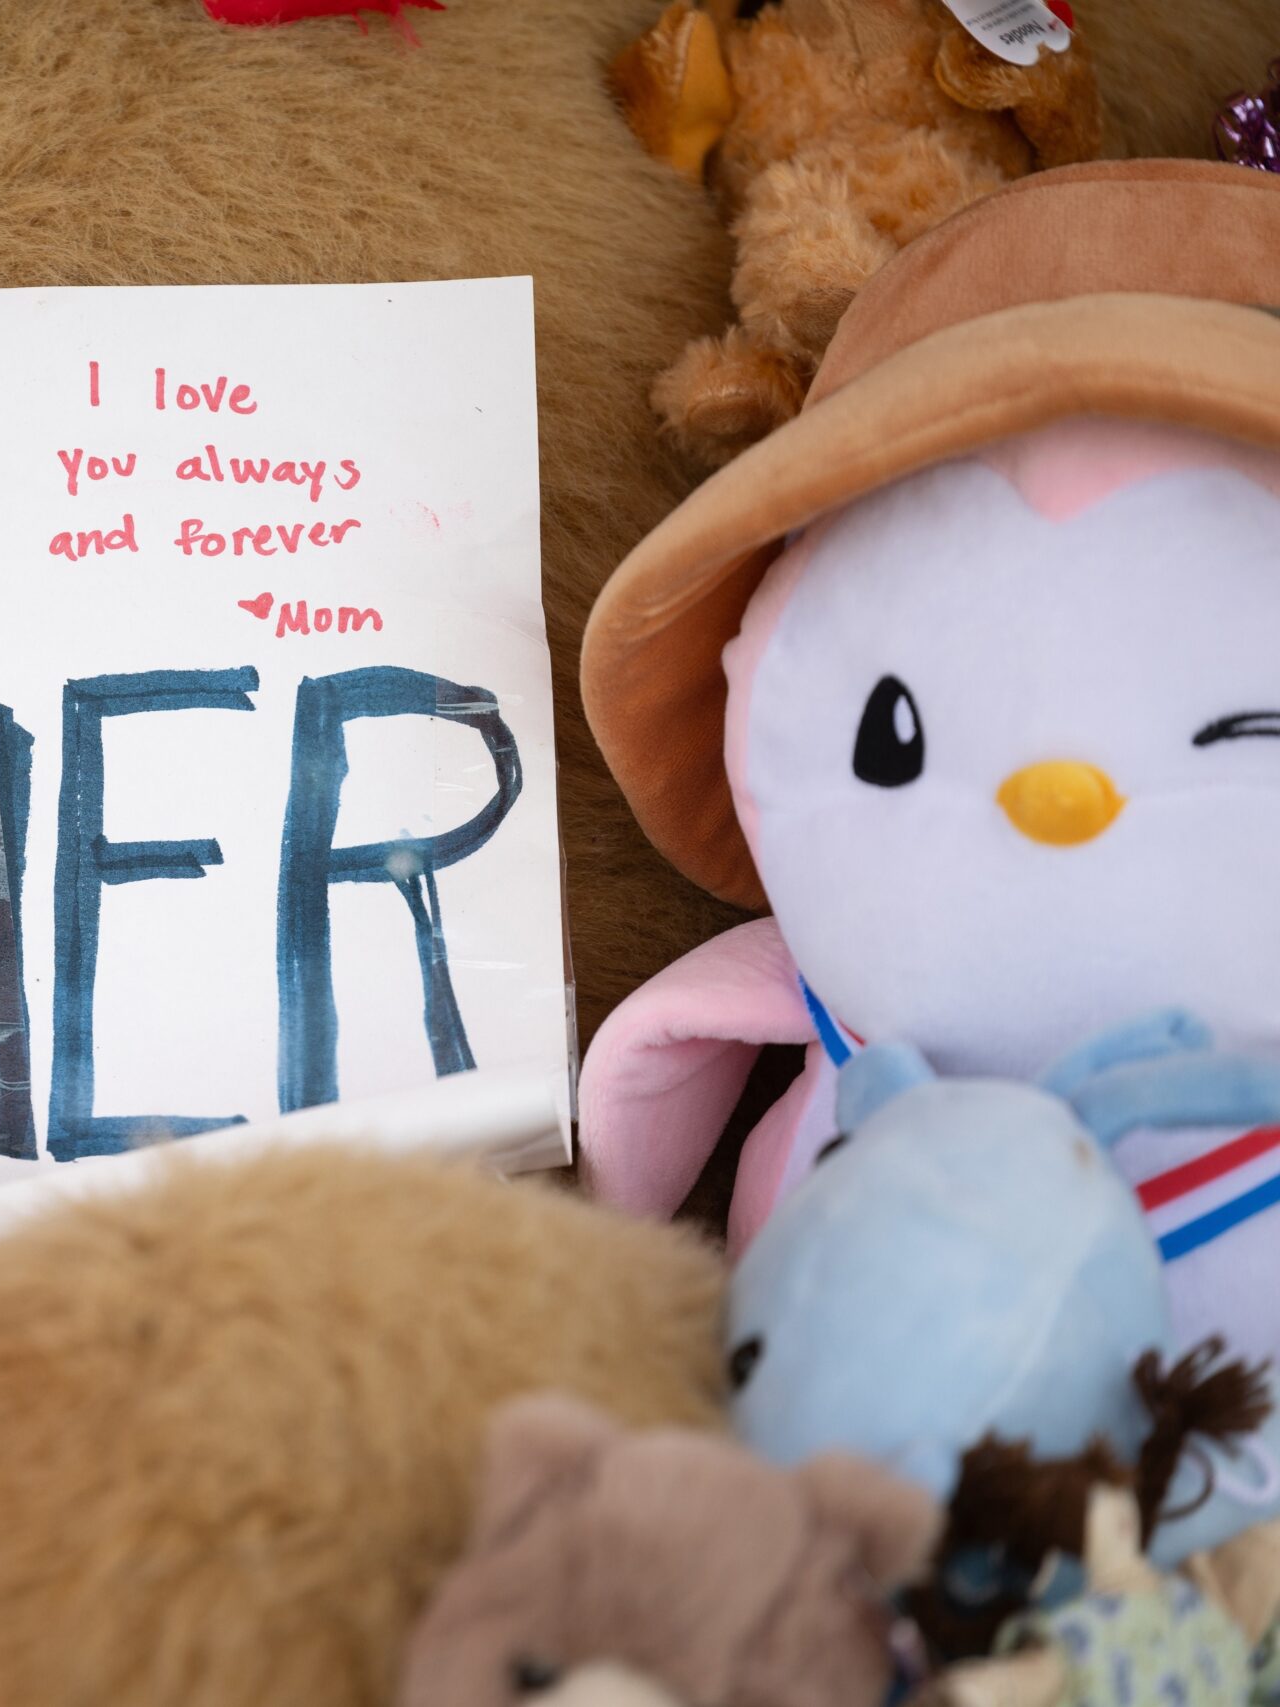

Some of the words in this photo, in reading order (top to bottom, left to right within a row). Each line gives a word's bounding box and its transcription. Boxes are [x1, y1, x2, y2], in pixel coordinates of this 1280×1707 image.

[998, 20, 1047, 45] Noodles
[89, 361, 100, 406] I
[155, 368, 257, 415] love
[57, 448, 136, 496] you
[176, 444, 361, 503] always
[49, 513, 138, 561] and
[174, 519, 361, 557] forever
[275, 600, 383, 638] Mom
